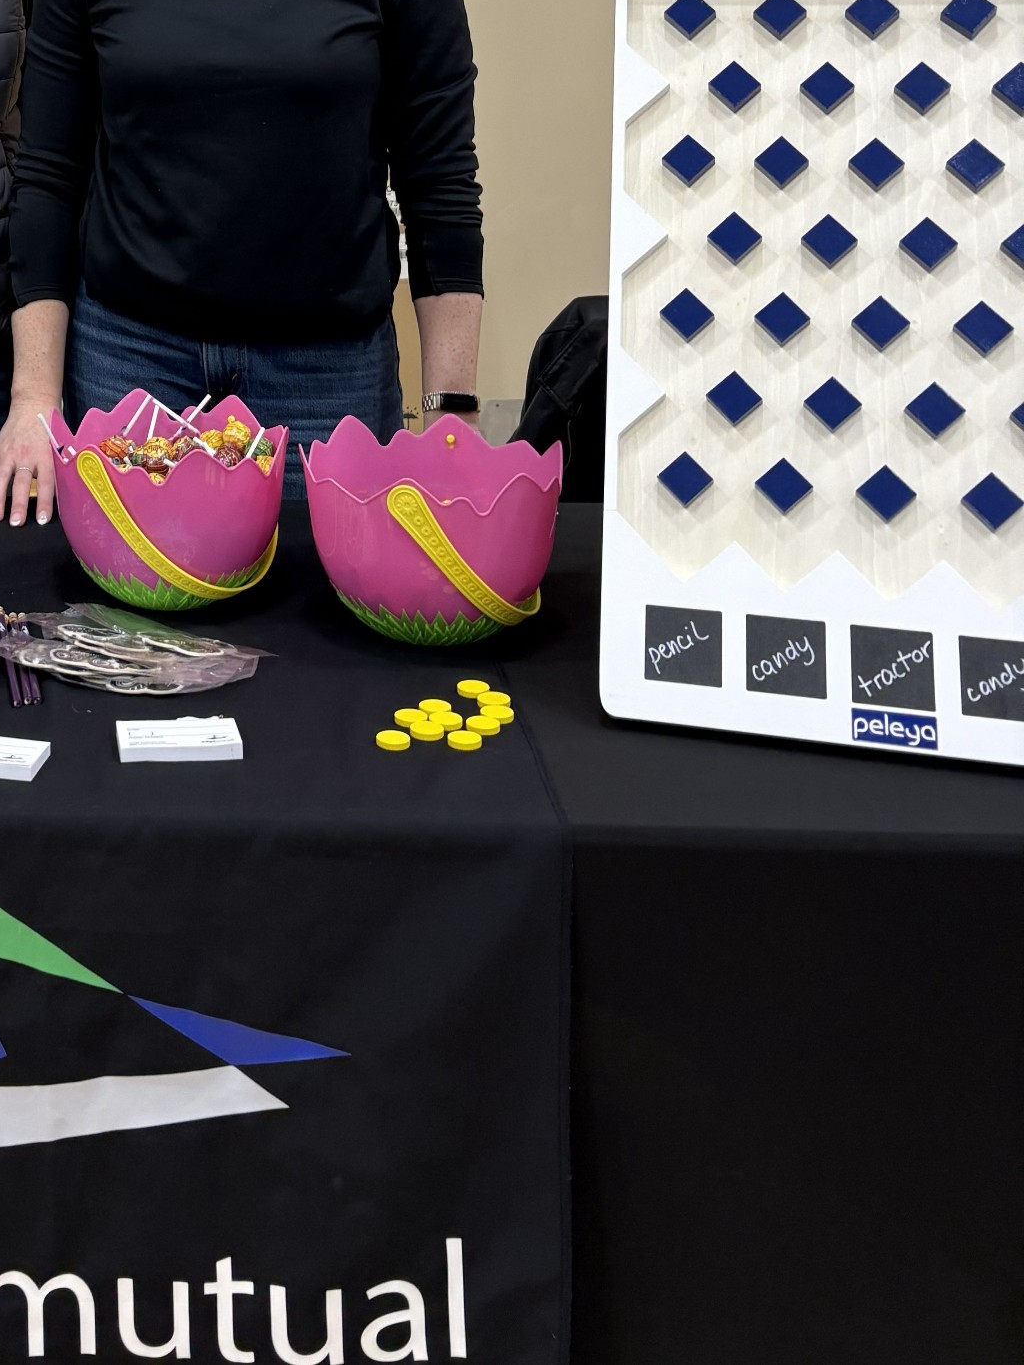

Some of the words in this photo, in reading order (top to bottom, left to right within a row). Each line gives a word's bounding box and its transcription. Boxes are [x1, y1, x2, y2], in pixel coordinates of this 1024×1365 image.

[648, 620, 711, 675] pencil
[751, 635, 816, 682] candy
[858, 640, 933, 698] tractor
[853, 714, 936, 746] peleya
